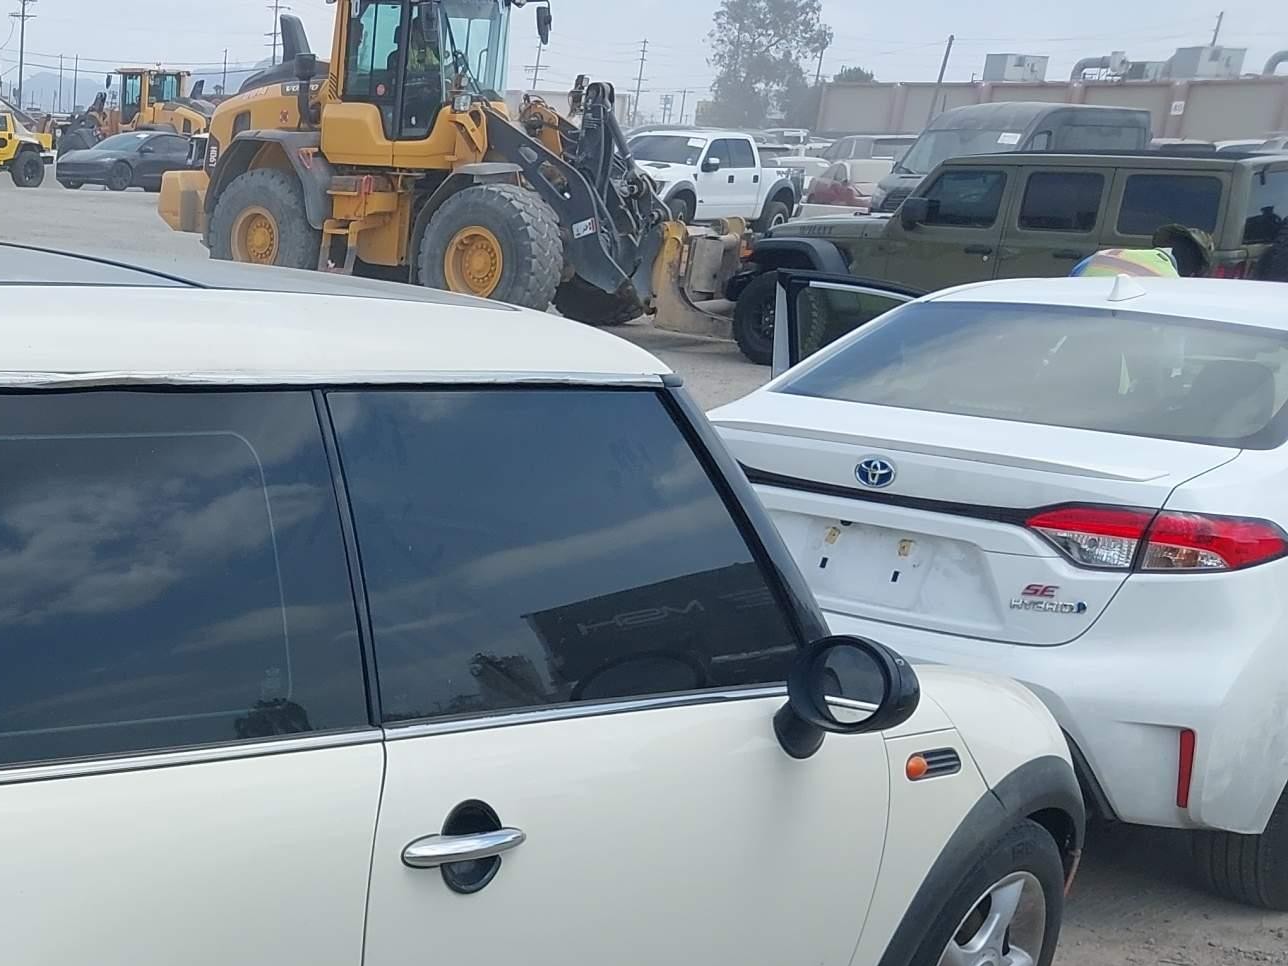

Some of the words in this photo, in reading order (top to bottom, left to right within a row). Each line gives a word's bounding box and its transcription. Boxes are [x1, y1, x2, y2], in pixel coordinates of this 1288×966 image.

[285, 84, 319, 92] VOO
[1021, 583, 1060, 598] SE
[1009, 599, 1075, 614] HYBRID
